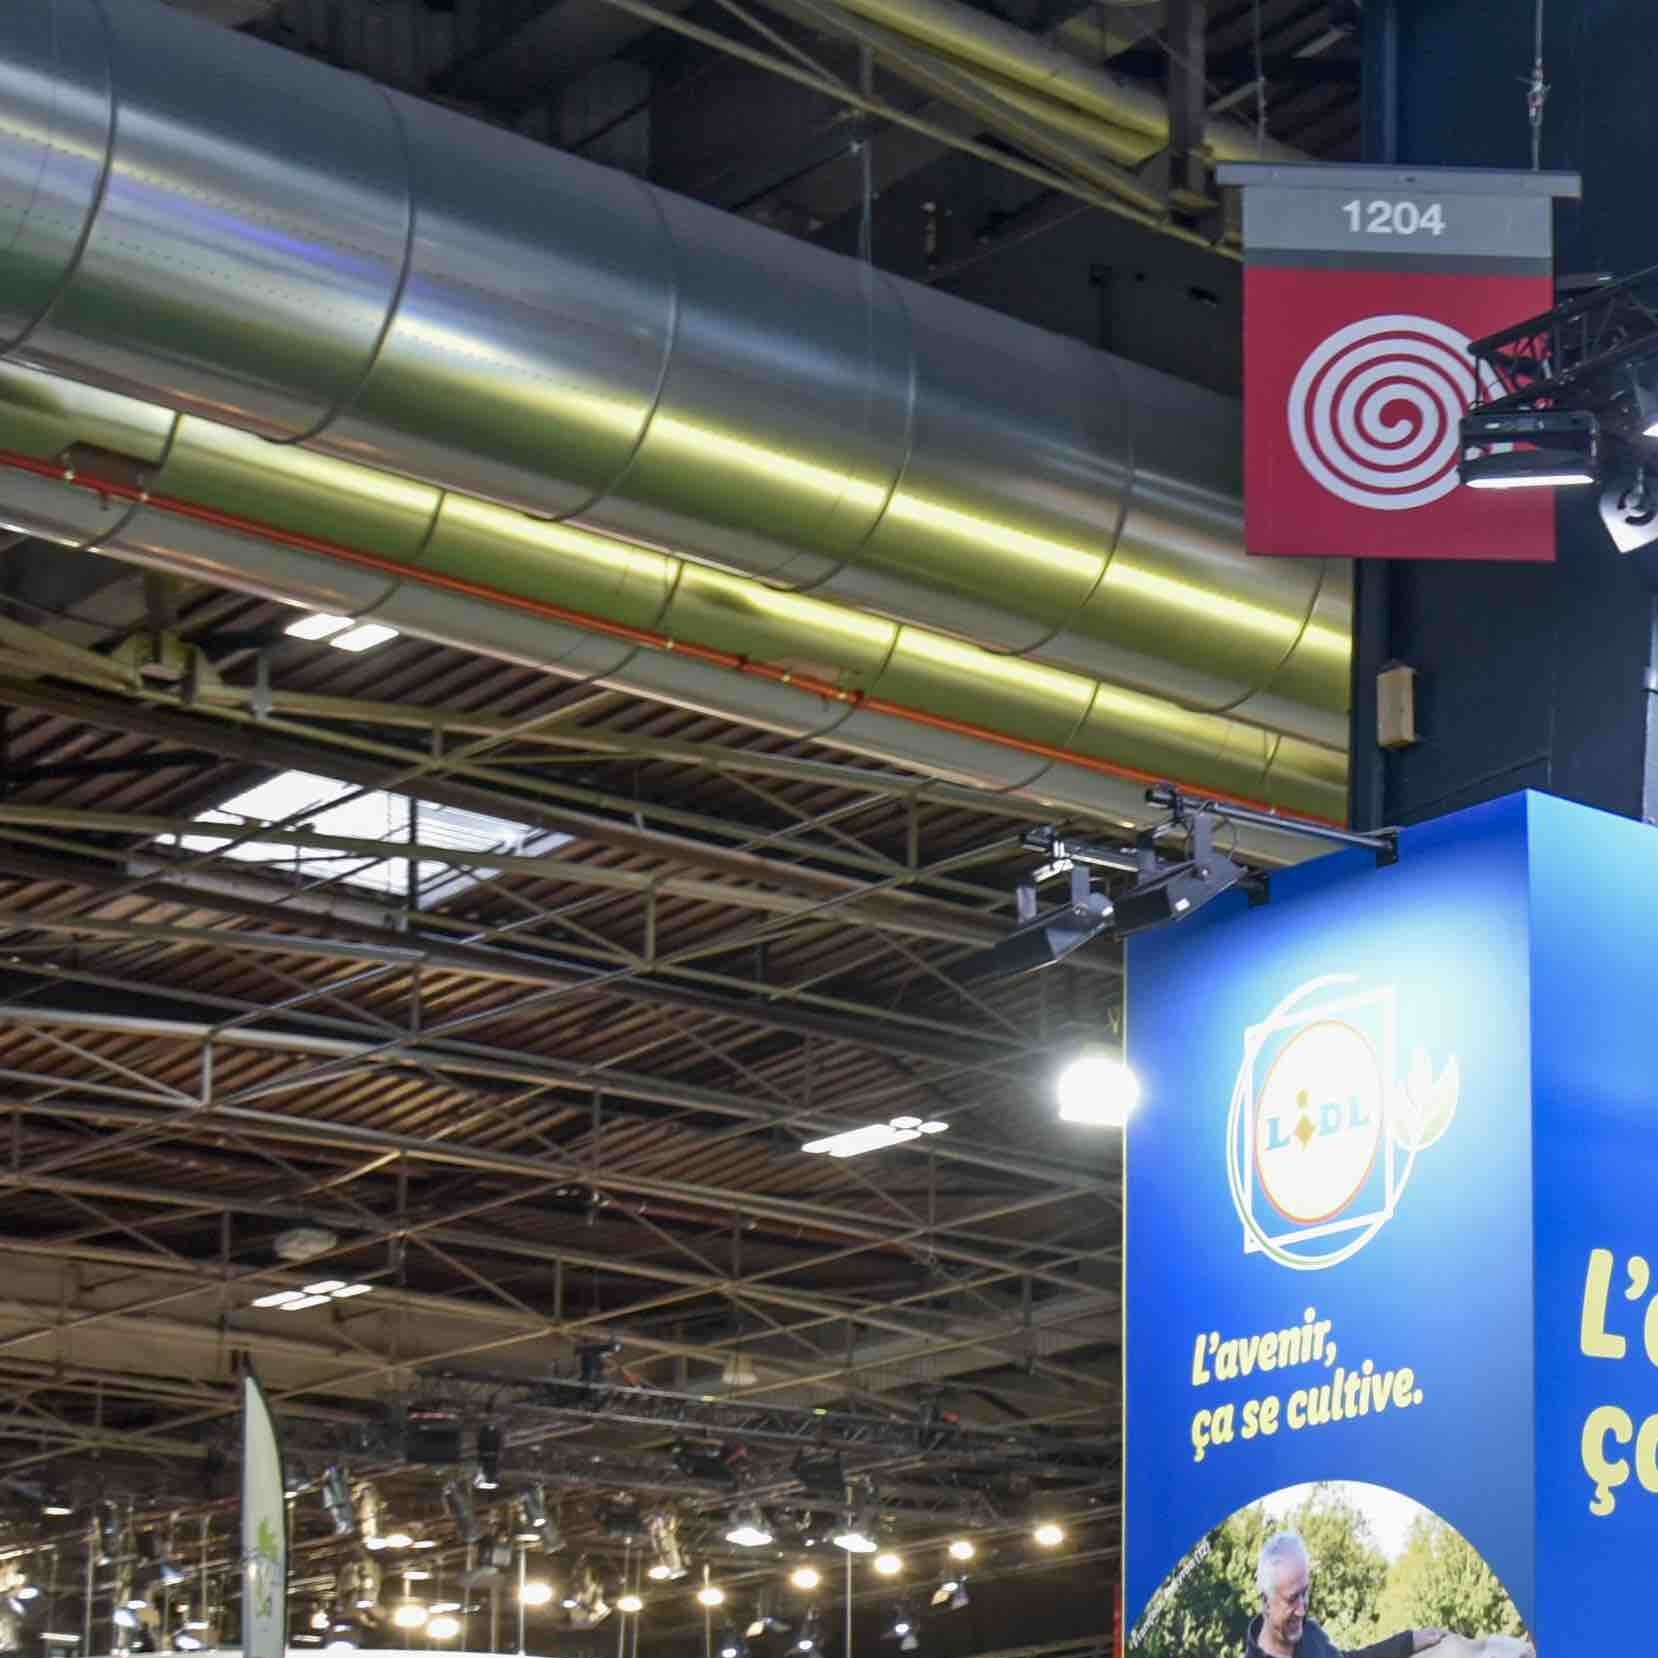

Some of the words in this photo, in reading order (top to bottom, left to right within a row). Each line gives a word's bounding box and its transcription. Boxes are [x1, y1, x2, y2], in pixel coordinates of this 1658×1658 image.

[1341, 201, 1447, 235] 1204
[1264, 1090, 1372, 1151] LIDL
[1191, 1307, 1337, 1386] L'avenir,
[1191, 1404, 1235, 1463] ça
[1241, 1391, 1280, 1438] se
[1286, 1359, 1424, 1430] cultive.
